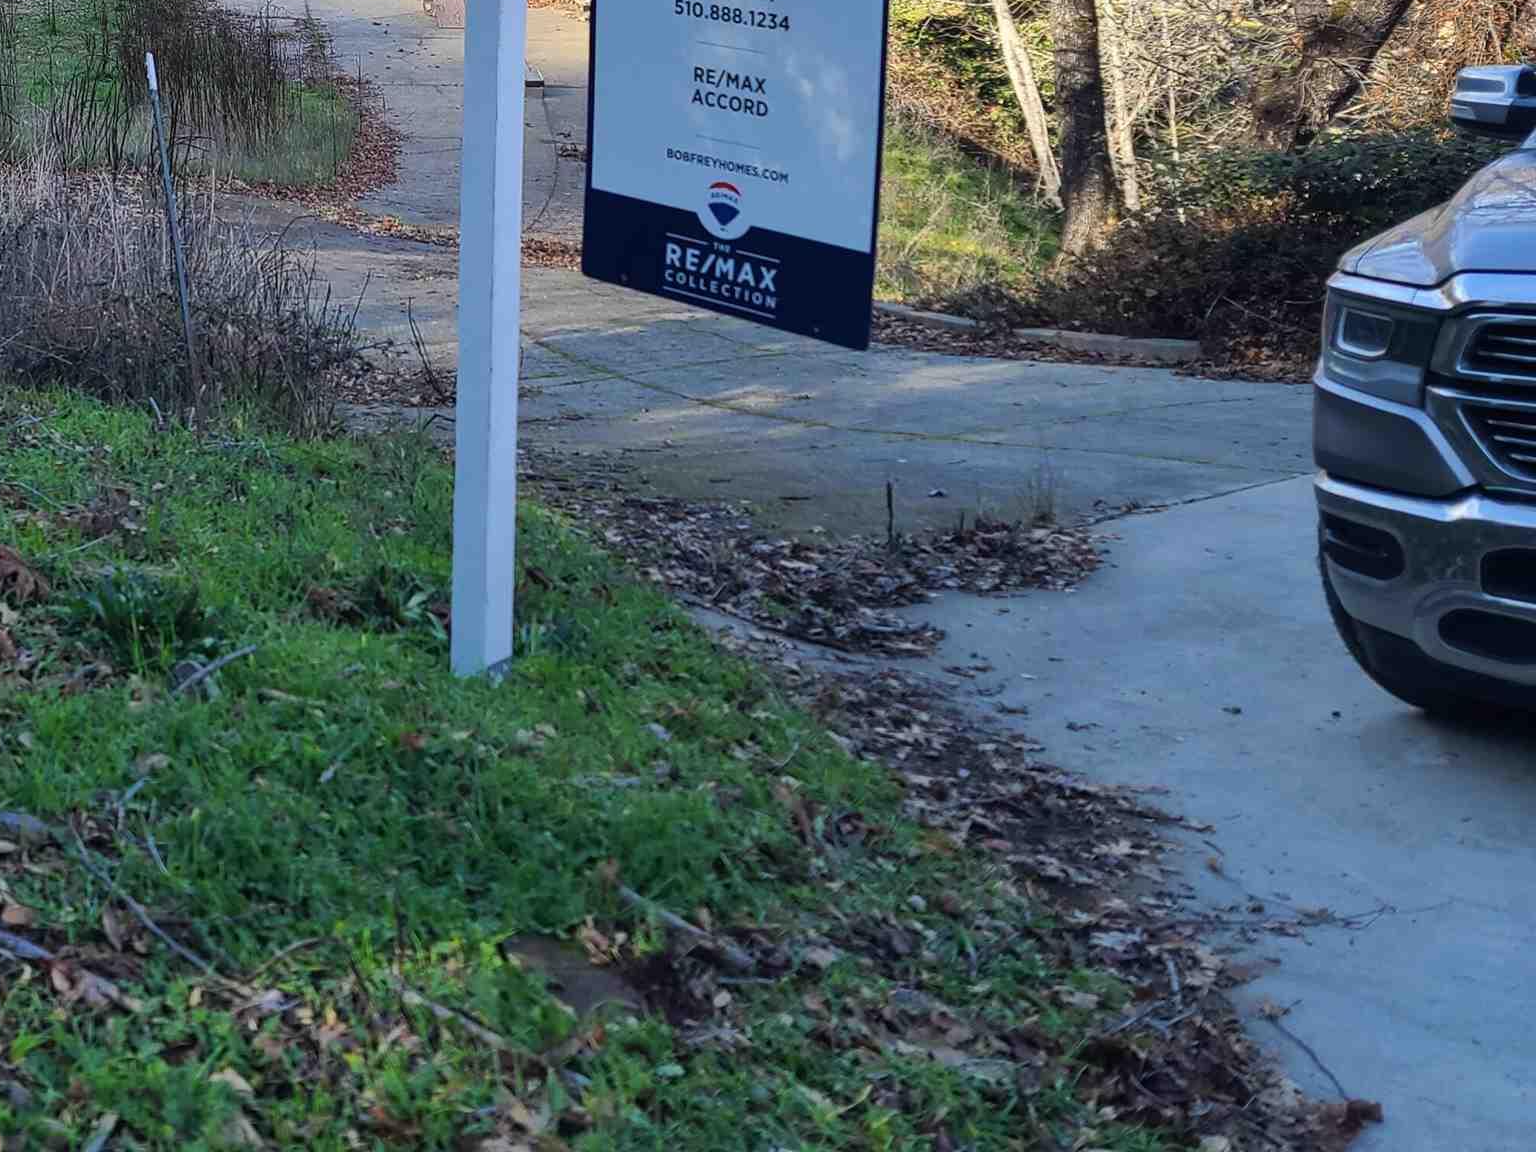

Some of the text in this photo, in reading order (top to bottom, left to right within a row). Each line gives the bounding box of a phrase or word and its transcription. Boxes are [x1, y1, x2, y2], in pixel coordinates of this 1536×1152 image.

[674, 0, 790, 31] 510.888.1234
[694, 66, 767, 95] RE/MAX
[692, 89, 768, 117] ACCORD
[666, 147, 789, 184] BOBFREYHOMES.COM
[665, 242, 777, 292] RE/MAX
[664, 269, 776, 309] COLLECTION
